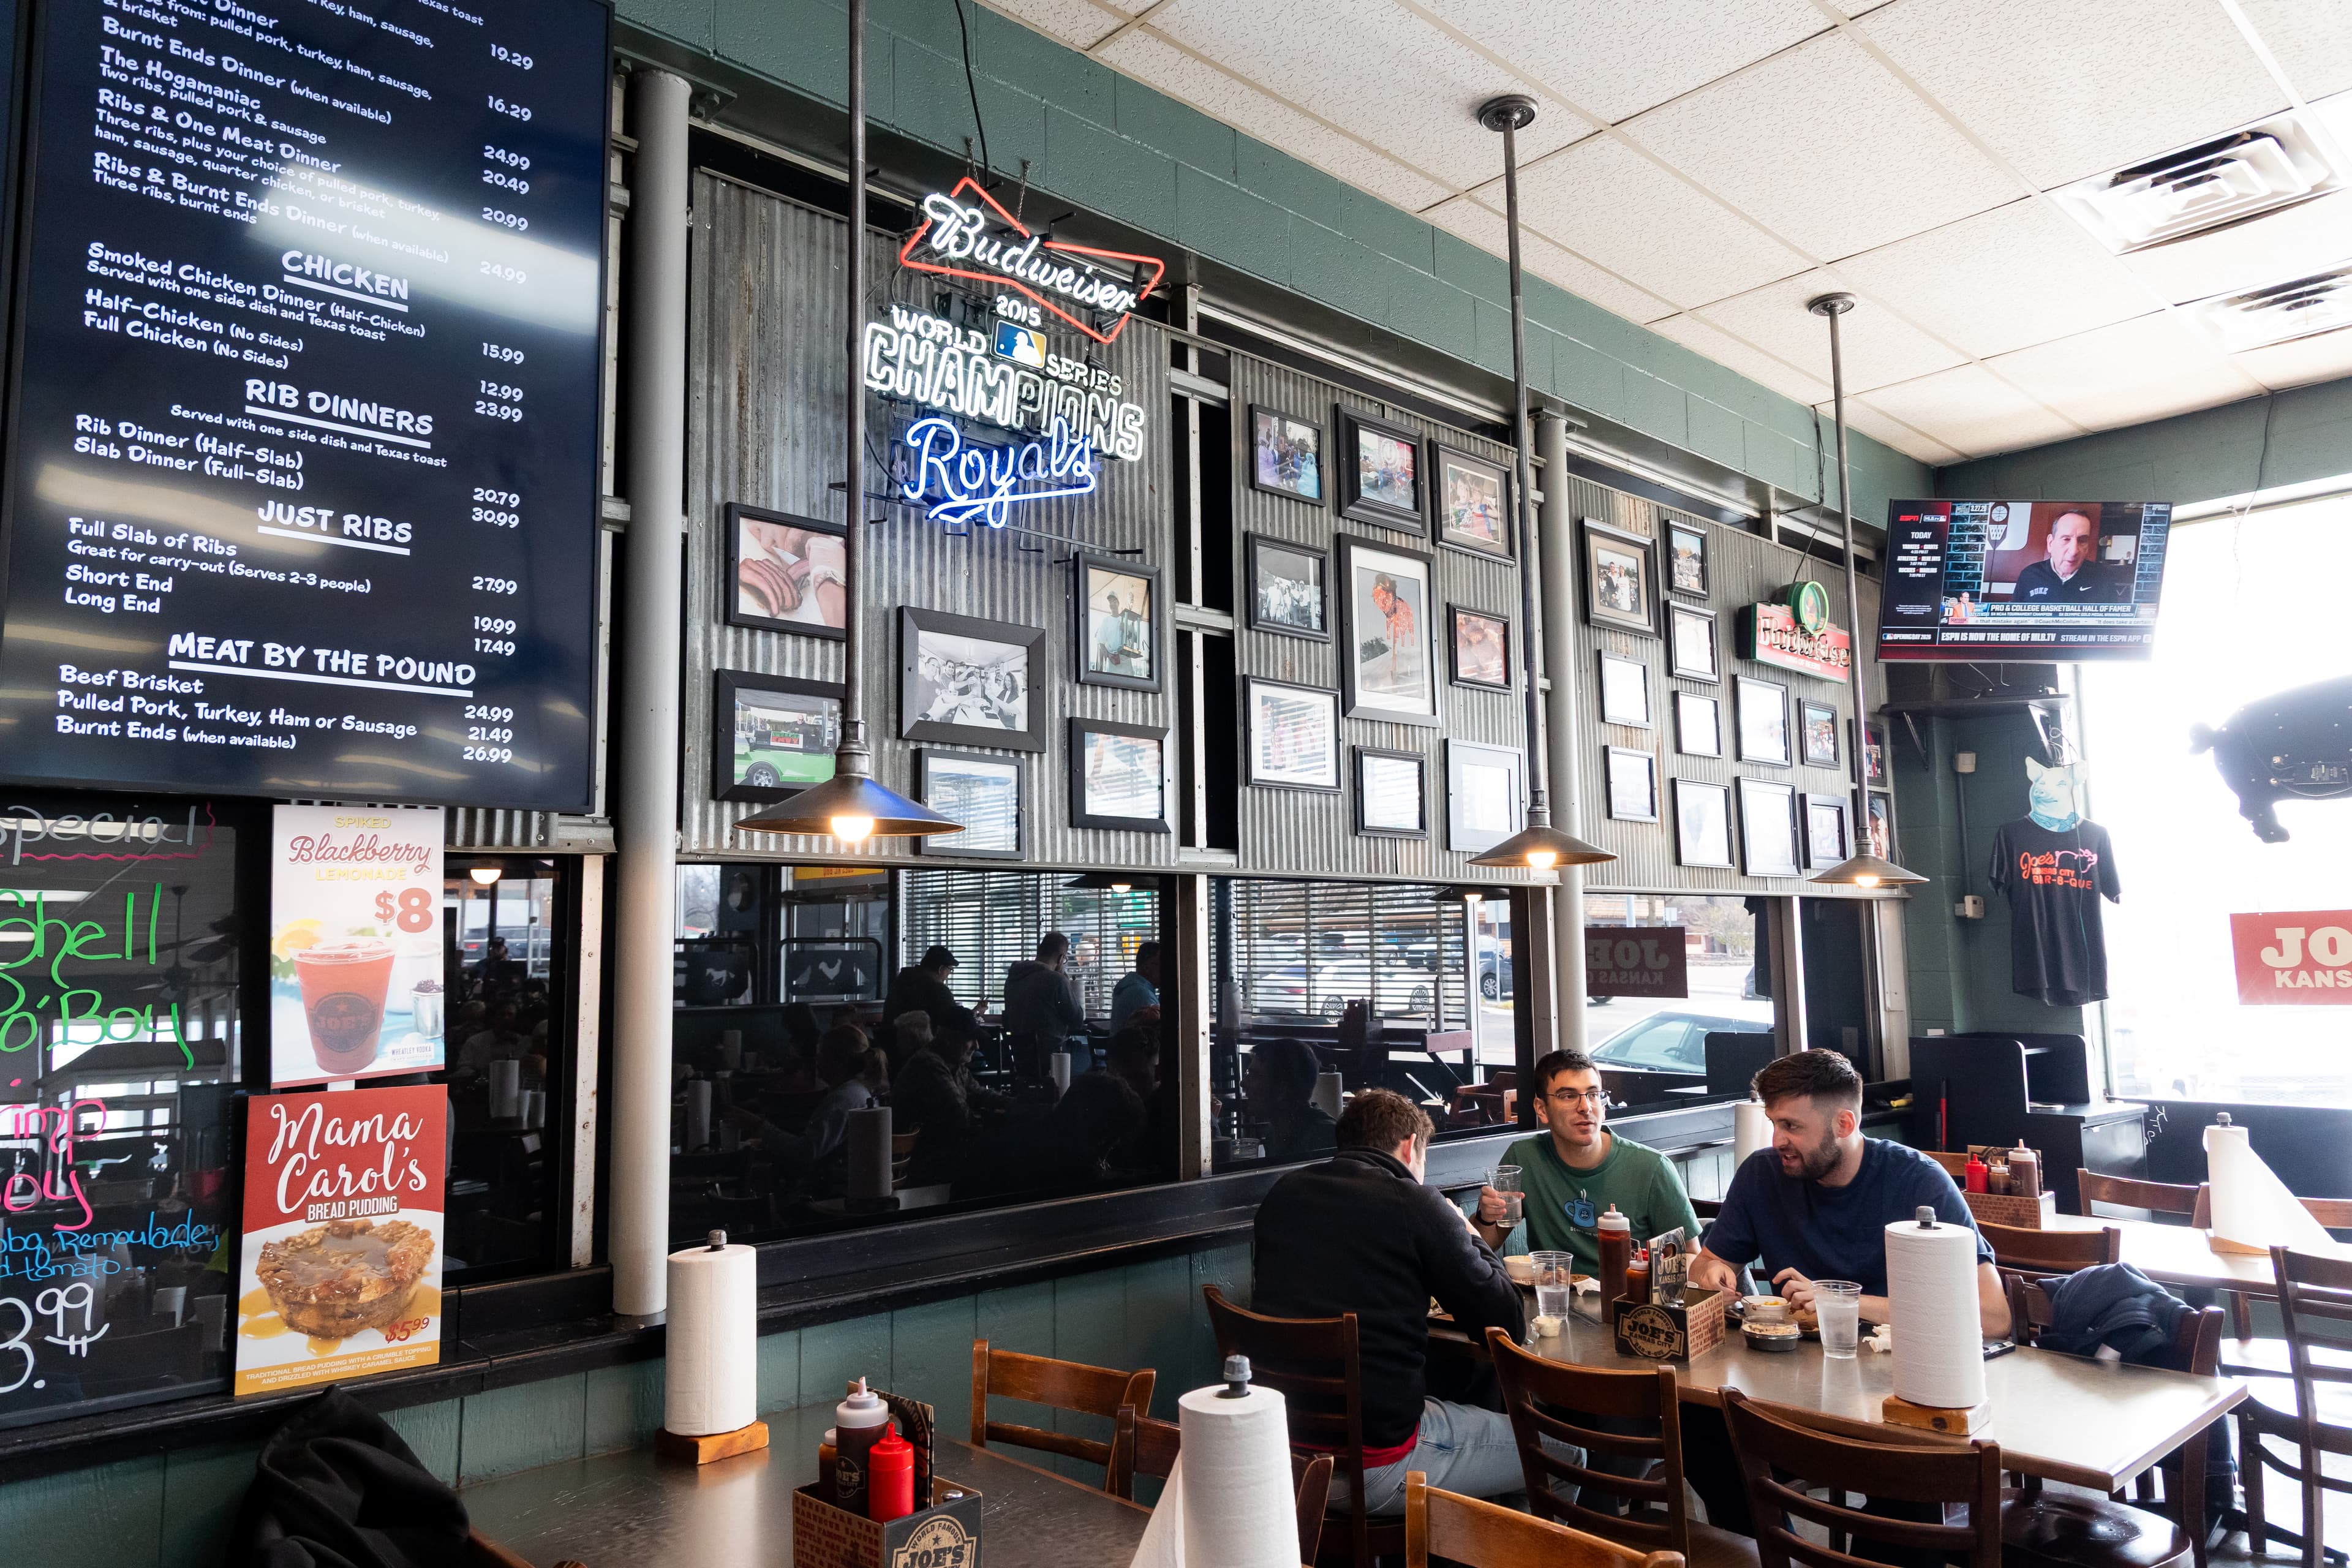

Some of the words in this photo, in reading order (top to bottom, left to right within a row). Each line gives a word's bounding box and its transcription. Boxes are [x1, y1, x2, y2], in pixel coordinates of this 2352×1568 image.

[491, 43, 533, 70] 19.29
[100, 45, 139, 71] The
[145, 59, 261, 110] Hogamaniac
[102, 16, 164, 49] Burnt
[169, 39, 216, 66] Ends
[221, 56, 286, 89] Dinner
[290, 79, 328, 104] (when
[331, 99, 391, 125] available)
[99, 62, 129, 82] Two
[132, 77, 166, 96] ribs,
[170, 88, 213, 109] pulled
[217, 104, 251, 122] pork
[254, 113, 268, 126] &
[271, 121, 327, 145] sausage
[488, 95, 532, 121] 16.29
[483, 145, 530, 170] 24.99
[482, 170, 530, 195] 20.49
[481, 207, 529, 231] 20.99
[924, 193, 1137, 312] Budweiser
[282, 250, 408, 300] CHICKEN
[480, 261, 527, 284] 24.99
[86, 243, 172, 276] Smoked
[178, 264, 257, 296] Chicken
[262, 284, 326, 312] Dinner
[330, 302, 426, 338] (Half-Chicken)
[86, 260, 145, 284] Served
[148, 277, 181, 293] with
[184, 286, 211, 300] one
[214, 292, 246, 308] side
[249, 299, 277, 316] dish
[280, 309, 304, 322] and
[307, 312, 346, 332] Texas
[349, 323, 386, 342] toast
[995, 295, 1041, 327] 2015
[483, 342, 524, 364] 15.99
[892, 304, 987, 355] WORLD
[1046, 353, 1122, 396] SERIES
[480, 380, 524, 402] 12.99
[864, 322, 1144, 462] CHAMPIONS
[245, 379, 299, 409] RIB
[307, 391, 433, 435] DINNERS
[474, 401, 523, 423] 23.99
[76, 414, 111, 435] Rib
[118, 421, 190, 448] Dinner
[195, 432, 303, 470] (Half-Slab)
[903, 417, 1096, 529] Royals
[473, 487, 520, 508] 20.79
[258, 500, 334, 532] JUST
[342, 514, 412, 543] RIBS
[472, 507, 519, 529] 30.99
[69, 517, 105, 537] Full
[111, 524, 157, 545] Slab
[164, 533, 189, 549] of
[192, 535, 237, 557] Ribs
[67, 540, 117, 559] Great
[119, 548, 146, 562] for
[149, 556, 225, 573] carry-out
[228, 560, 286, 582] (Serves
[288, 571, 317, 586] 2-3
[320, 578, 371, 594] people)
[472, 576, 518, 595] 27.99
[2029, 587, 2049, 597] DUKE
[473, 616, 516, 635] 19.99
[1941, 633, 1959, 641] ESPN
[1961, 633, 1967, 641] IS
[1969, 633, 1986, 641] NOW
[1986, 633, 2000, 641] THE
[2000, 633, 2021, 641] HOME
[2030, 633, 2056, 642] MLB.TV
[474, 638, 516, 657] 17.49
[1759, 616, 1851, 668] Budweise
[168, 632, 255, 664] MEAT
[262, 642, 306, 668] BY
[313, 649, 369, 675] THE
[375, 654, 476, 685] POUND
[57, 689, 124, 712] Pulled
[130, 695, 188, 720] Pork,
[194, 702, 263, 727] Turkey,
[268, 707, 310, 728] Ham
[315, 717, 337, 729] or
[341, 715, 418, 739] Sausage
[464, 704, 514, 723] 24.99
[467, 726, 513, 744] 21.49
[462, 745, 513, 764] 26.99
[0, 805, 197, 865] pecial
[334, 816, 391, 828] SPIKED
[289, 833, 432, 874] Blackberry
[2020, 851, 2056, 879] Joe's
[315, 869, 407, 881] LEMONADE
[2032, 875, 2093, 889] BAR-B-QUE
[2059, 869, 2075, 877] CITY
[374, 888, 434, 933] $8
[391, 1047, 415, 1055] WHEATLEY
[268, 1102, 423, 1164] Mama
[277, 1140, 427, 1213] Carol's
[307, 1201, 345, 1221] BREAD
[349, 1196, 398, 1216] PUDDING
[1659, 1274, 1676, 1284] KANSAS
[1627, 1320, 1675, 1344] JOE'S
[1629, 1332, 1656, 1344] KANSAS
[1657, 1340, 1673, 1349] CITY
[246, 1367, 292, 1381] TRADITIONAL
[293, 1363, 315, 1373] BREAD
[317, 1359, 347, 1370] PUDDING
[349, 1356, 365, 1365] WITH
[372, 1351, 402, 1361] CRUMBLE
[404, 1346, 432, 1356] TOPPING
[278, 1372, 311, 1383] DRIZZLED
[312, 1368, 330, 1378] WITH
[331, 1364, 361, 1375] WHISKEY
[362, 1359, 393, 1370] CARAMEL
[911, 1525, 935, 1550] WORLD
[938, 1523, 961, 1544] FAMOUS
[902, 1544, 965, 1568] JOE'S
